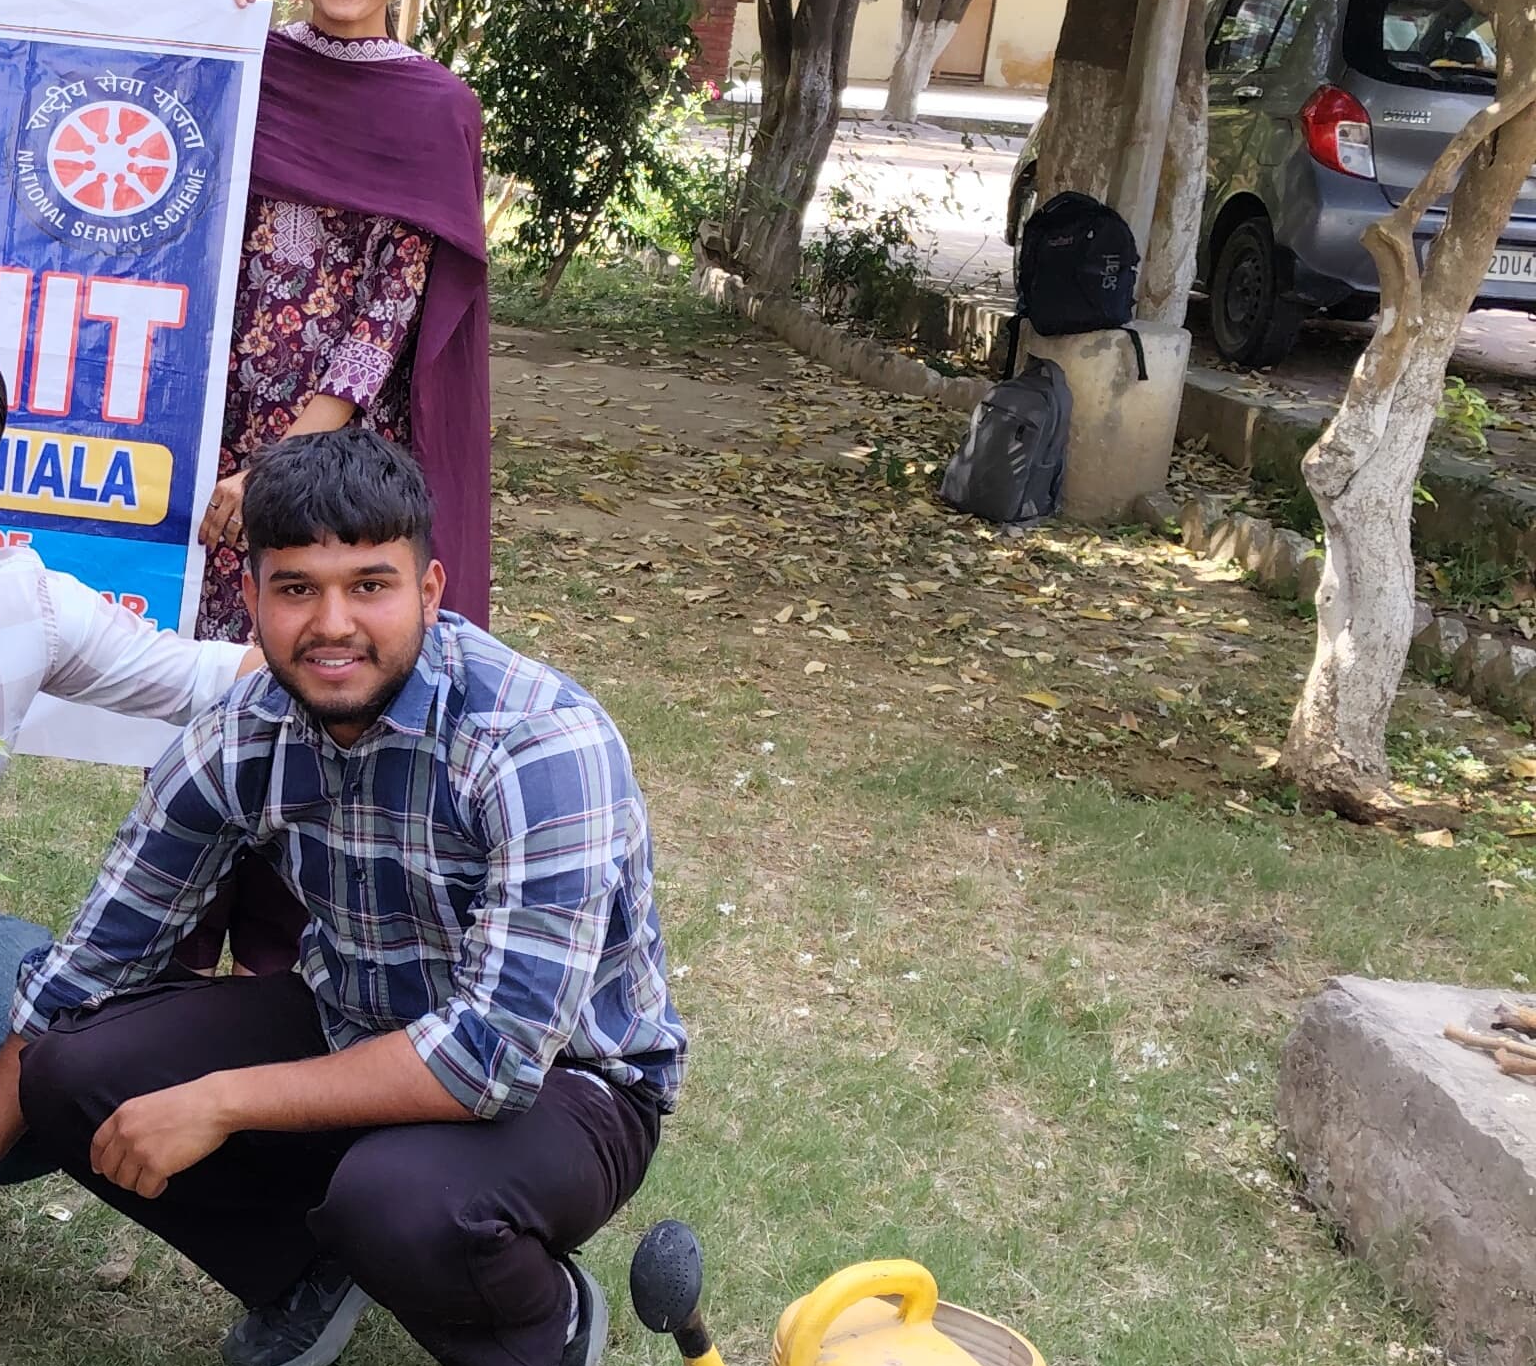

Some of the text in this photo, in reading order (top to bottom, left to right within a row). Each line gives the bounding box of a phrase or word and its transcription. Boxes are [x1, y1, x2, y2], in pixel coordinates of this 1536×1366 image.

[25, 70, 205, 149] राष्ट्रीय सेवा योजना
[18, 150, 207, 243] NATIONAL SERVICE SCHEME
[1487, 255, 1532, 276] 2DU4
